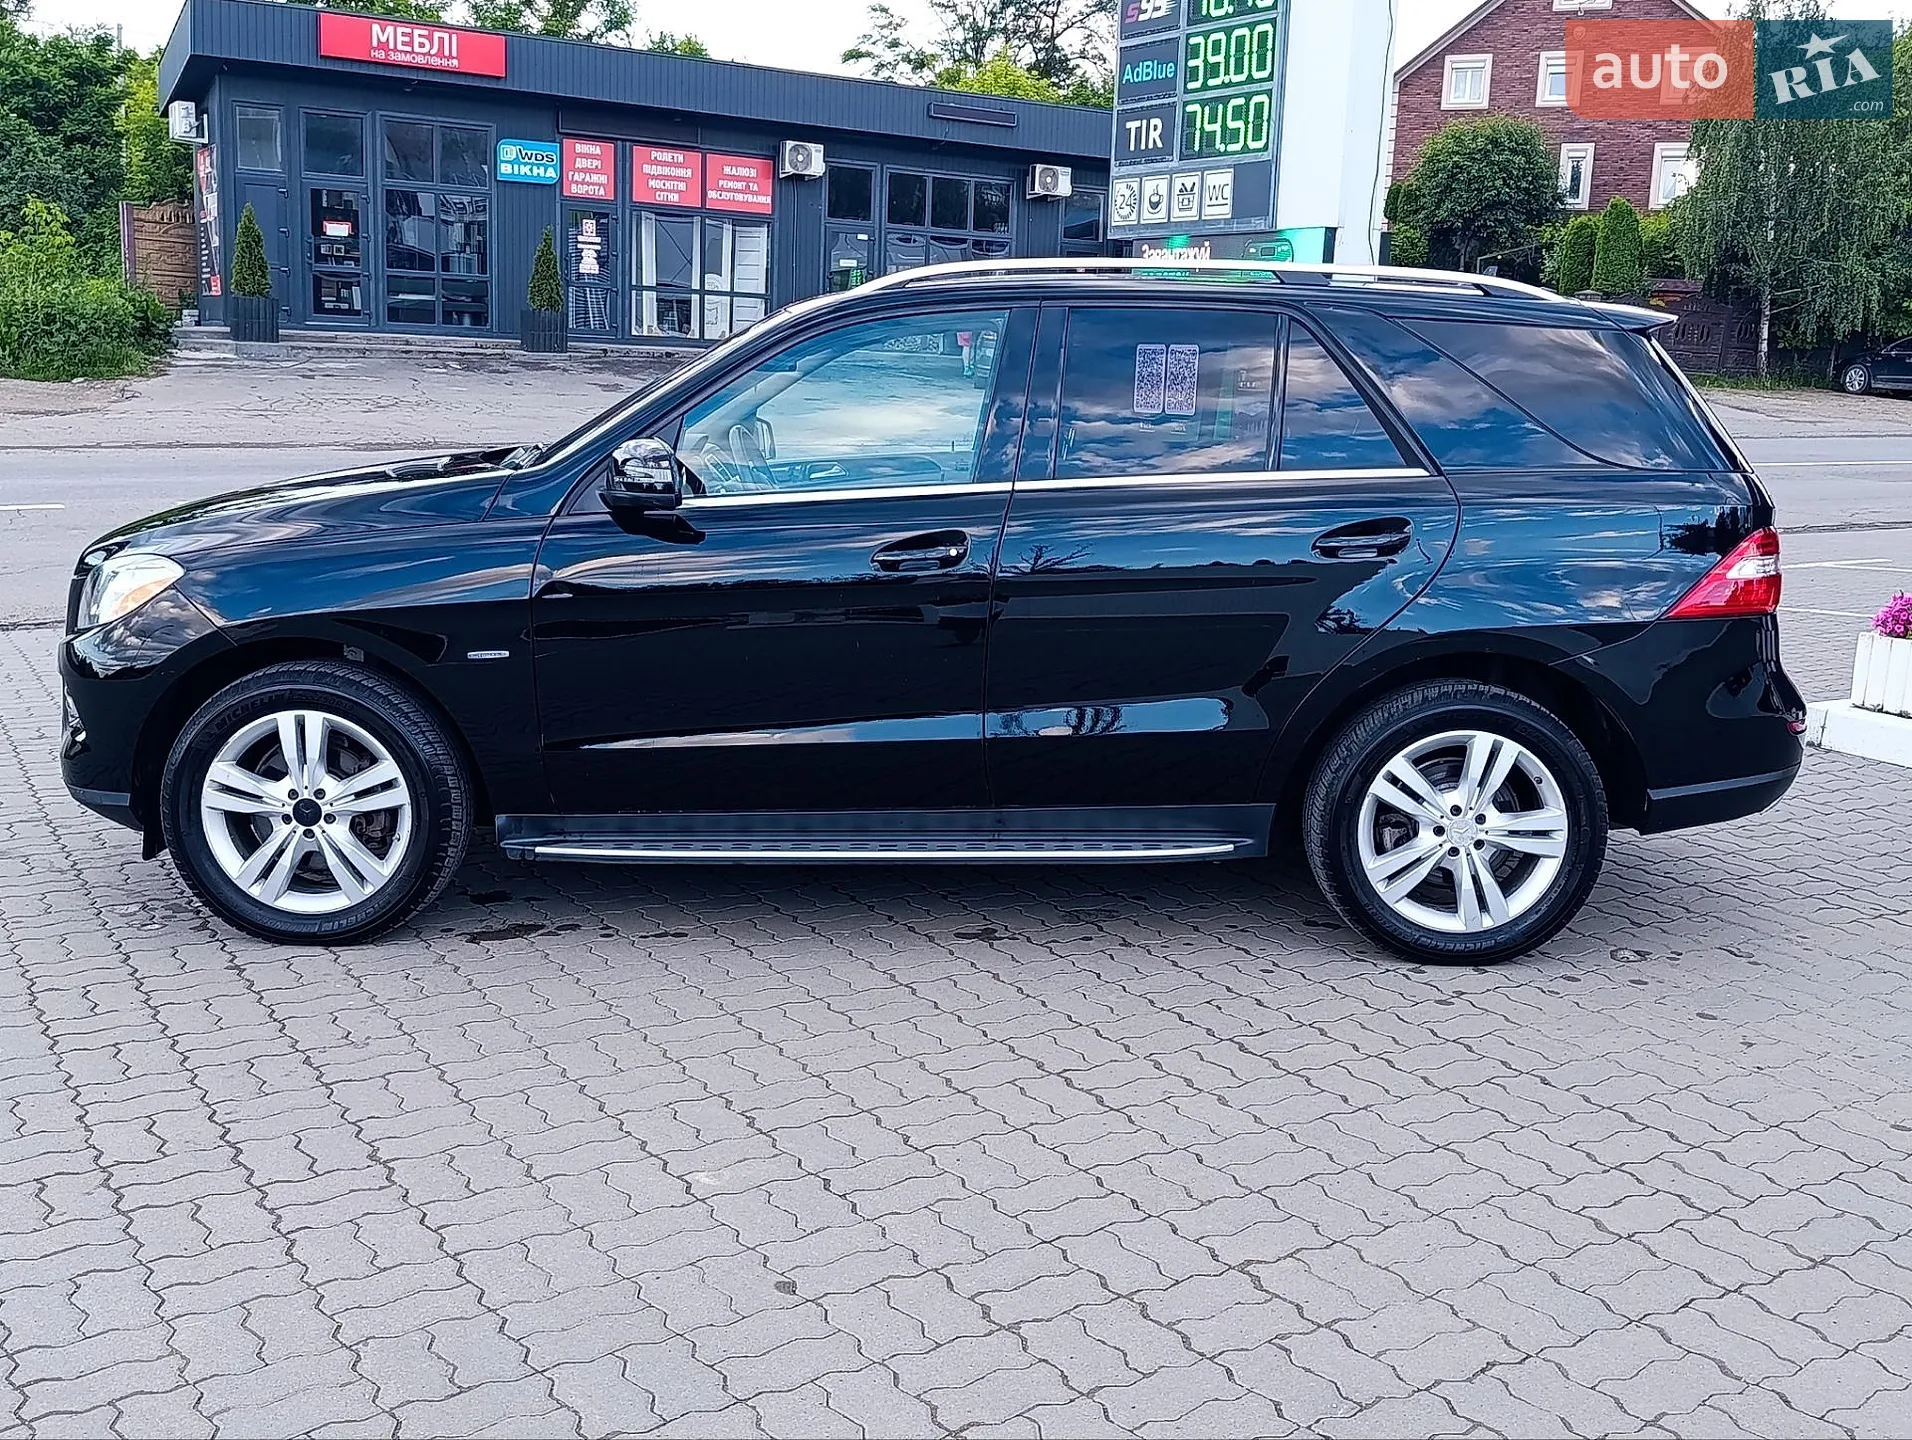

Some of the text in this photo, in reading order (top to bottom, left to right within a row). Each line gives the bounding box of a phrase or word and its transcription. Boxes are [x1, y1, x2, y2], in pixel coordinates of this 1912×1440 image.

[371, 23, 458, 57] МЕБЛІ
[370, 49, 459, 69] на замовлення
[1187, 22, 1273, 90] 39.00
[1122, 59, 1175, 84] AdBlue
[1185, 93, 1270, 152] 74.50
[1125, 117, 1163, 152] TIR
[518, 147, 555, 163] WDS
[575, 142, 601, 155] ВІКНА
[574, 157, 602, 170] ДВЕРІ
[650, 150, 684, 164] РОЛЕТИ
[500, 162, 557, 179] ВІКНА
[568, 171, 608, 184] ГАРАЖНІ
[642, 163, 693, 179] ПІДВІКОННЯ
[722, 164, 757, 178] ЖАЛЮЗІ
[570, 186, 606, 197] ВОРОТА
[647, 178, 687, 192] МОСКІТНІ
[717, 179, 759, 192] РЕМОНТ ТА
[1207, 183, 1230, 202] WC
[707, 190, 772, 205] ОБСЛУГОВУВАННЯ
